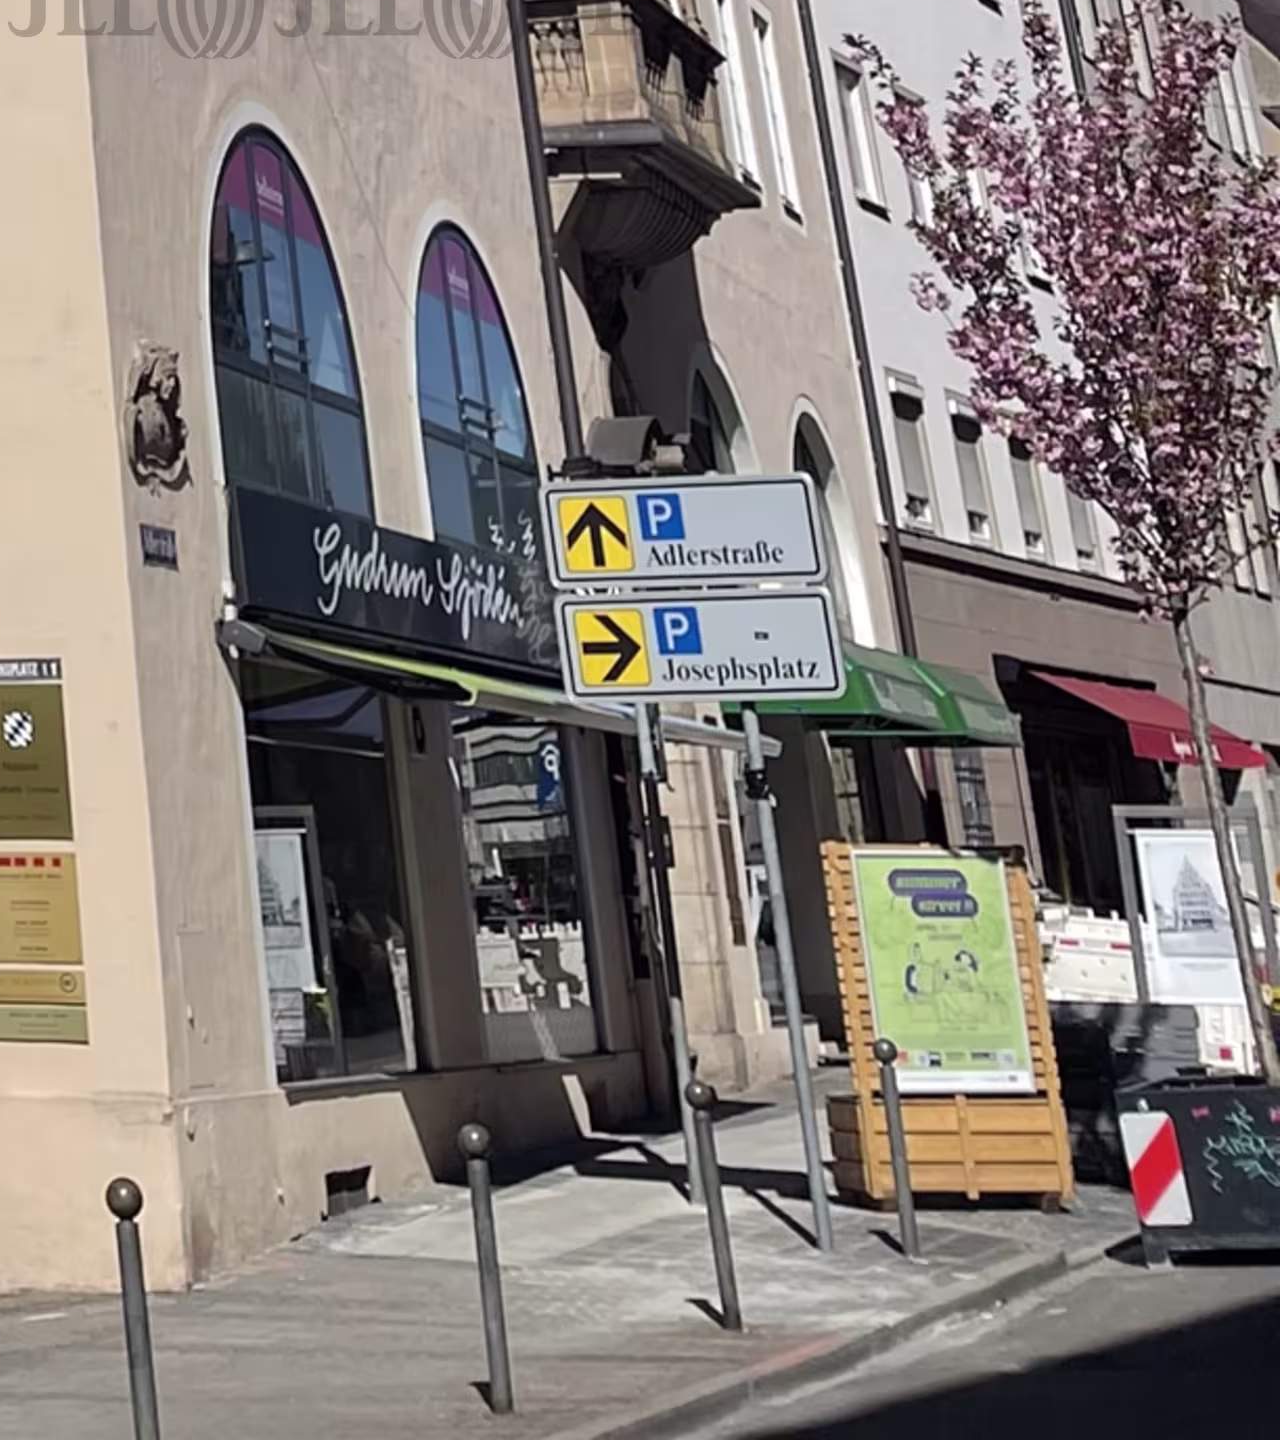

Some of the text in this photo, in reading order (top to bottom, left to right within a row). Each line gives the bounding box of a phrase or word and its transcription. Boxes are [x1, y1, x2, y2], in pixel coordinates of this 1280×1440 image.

[647, 540, 784, 568] Adlerstraße
[314, 523, 433, 615] Gudrun
[662, 657, 820, 686] Josephsplatz
